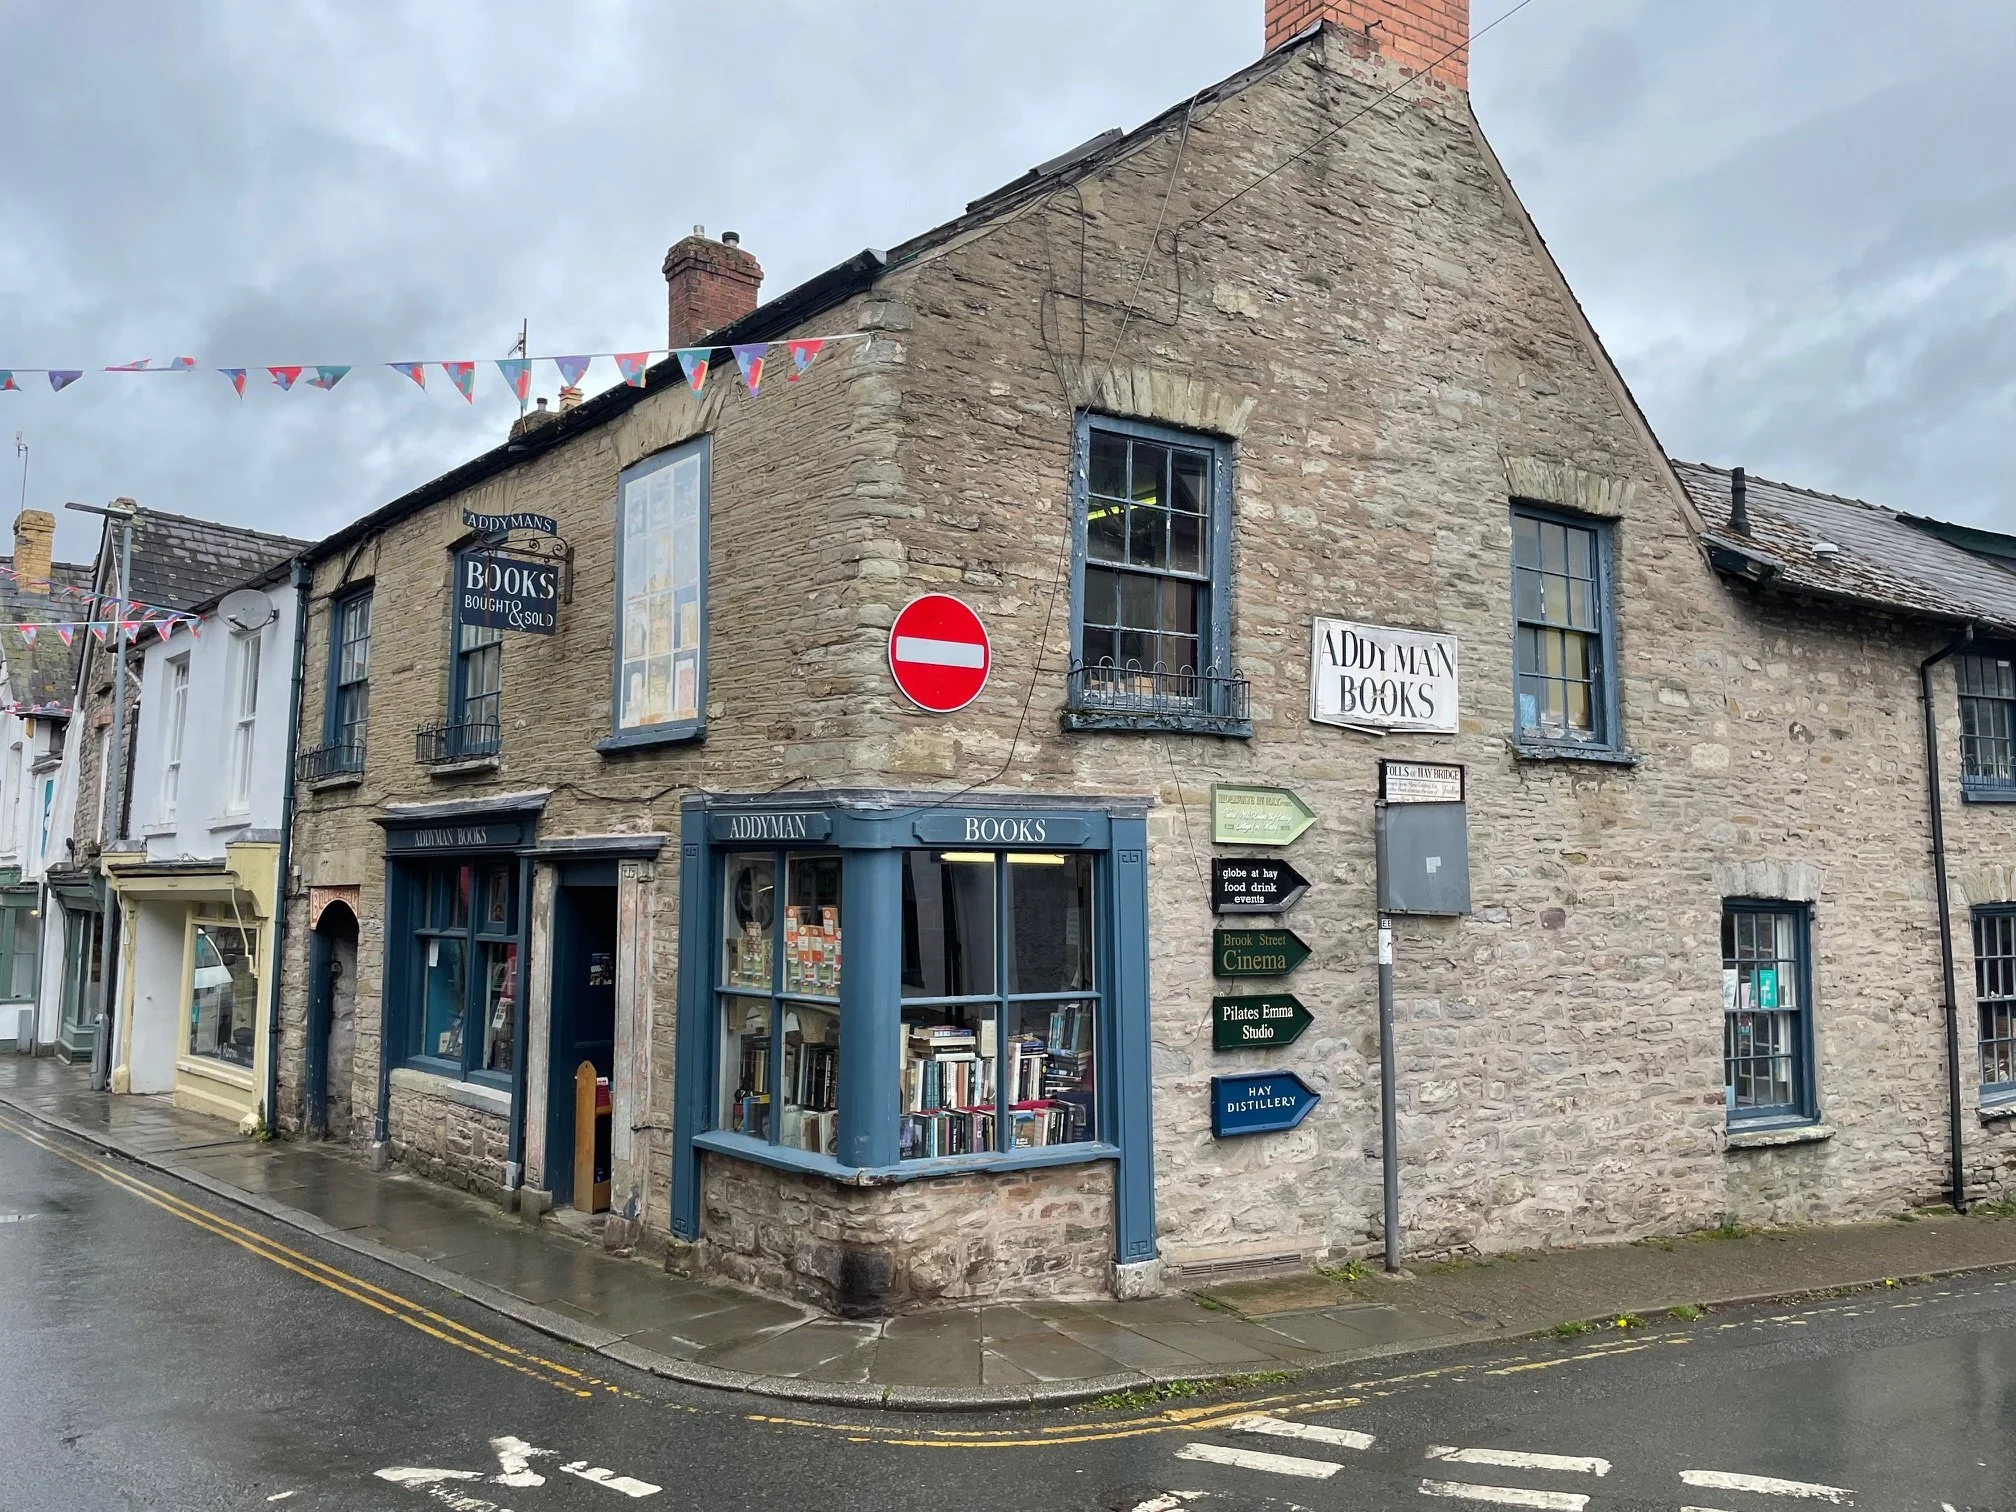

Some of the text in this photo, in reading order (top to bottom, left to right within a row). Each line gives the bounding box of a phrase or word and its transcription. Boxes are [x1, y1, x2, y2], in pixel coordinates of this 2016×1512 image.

[467, 514, 552, 531] ADDYMANS
[466, 561, 554, 599] BOOKS
[465, 594, 553, 628] BOUGHT & SOLD
[1320, 629, 1454, 679] ADDYMAN
[1340, 674, 1435, 719] BOOKS
[1433, 768, 1460, 780] BRIDGE
[729, 815, 807, 838] ADDYMAN
[964, 817, 1046, 842] BOOKS
[414, 827, 487, 846] ADDYMAN BOOKS
[1222, 868, 1278, 880] globe at hay
[1224, 882, 1277, 892] food drink
[1234, 895, 1265, 903] events
[1223, 933, 1286, 946] Brook Street
[1223, 949, 1287, 971] Cinema
[1223, 1004, 1293, 1021] Pilates Emma
[1242, 1024, 1274, 1040] Studio
[1249, 1086, 1271, 1096] HAY
[1227, 1096, 1296, 1112] DISTILLERY
